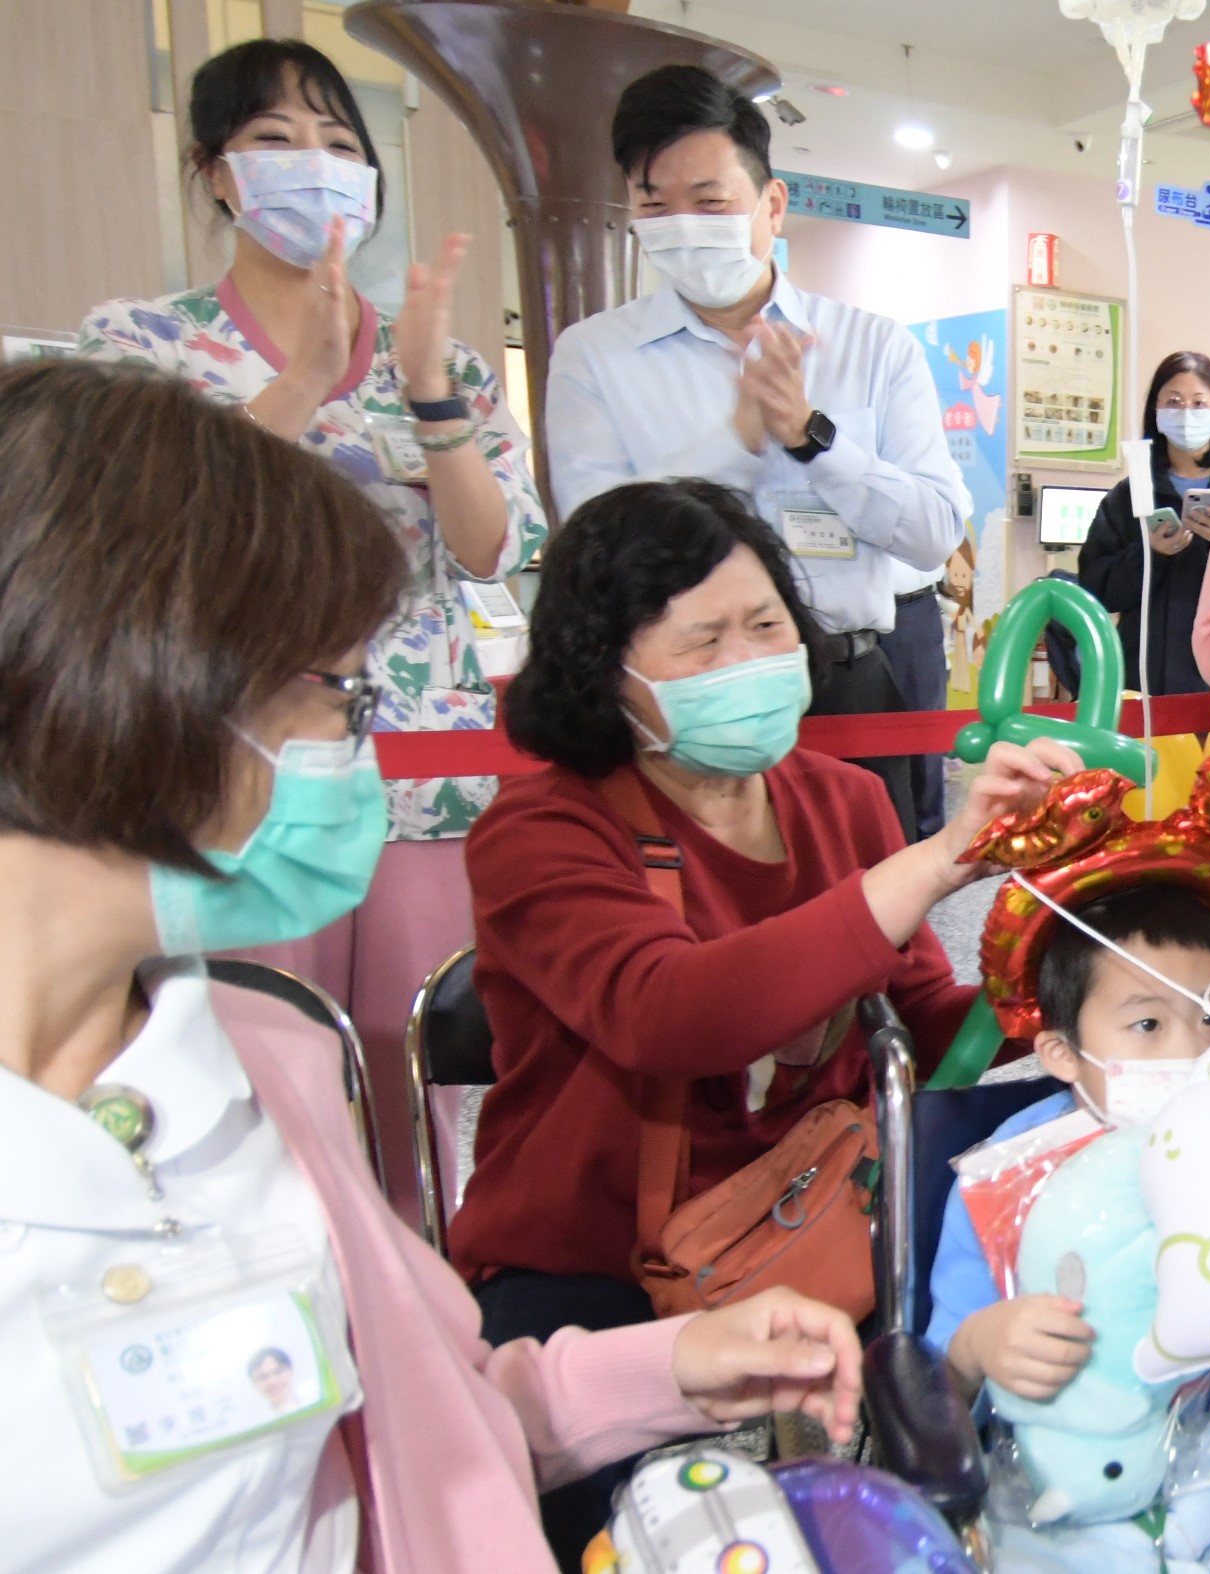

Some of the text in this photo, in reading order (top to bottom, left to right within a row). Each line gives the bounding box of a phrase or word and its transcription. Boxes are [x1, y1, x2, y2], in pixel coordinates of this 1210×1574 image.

[882, 195, 945, 220] 輪椅置放區
[1158, 188, 1197, 209] 尿布台
